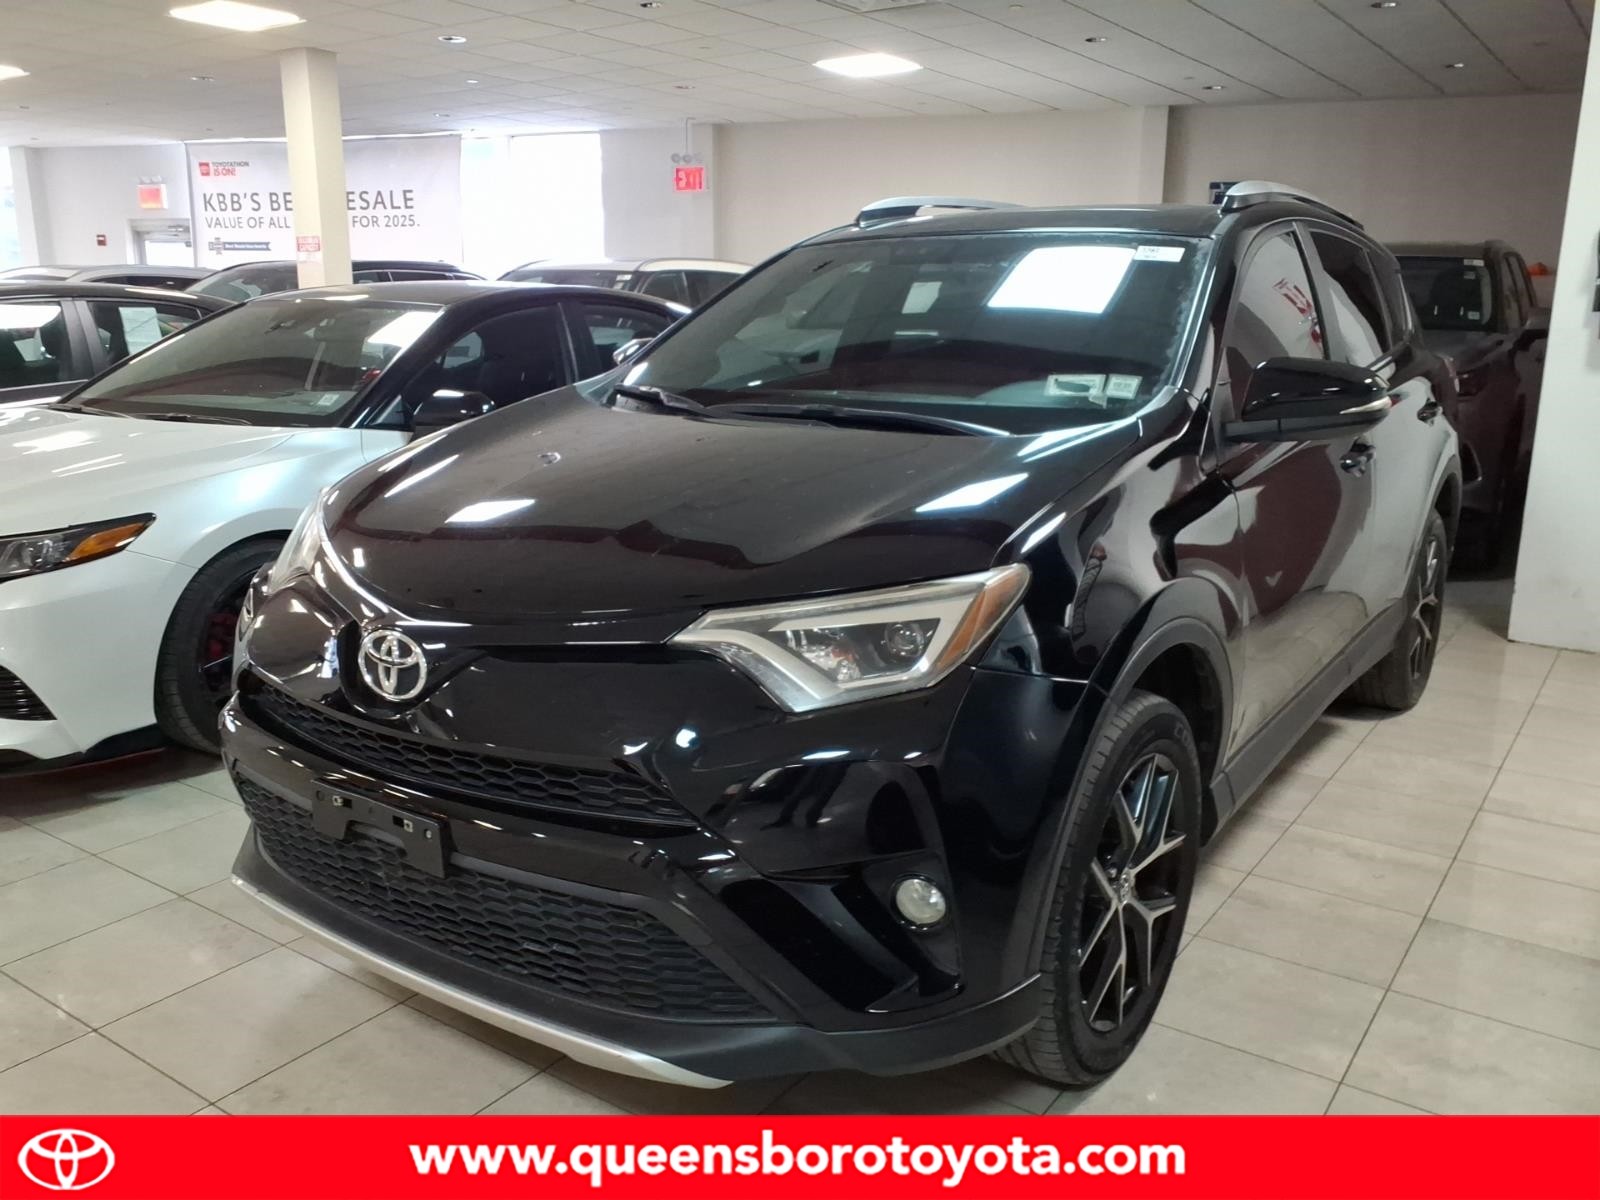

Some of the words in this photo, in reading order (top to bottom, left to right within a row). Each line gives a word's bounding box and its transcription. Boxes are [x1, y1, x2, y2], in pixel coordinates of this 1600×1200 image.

[675, 167, 704, 191] EXIT
[203, 192, 262, 212] KBB'S
[268, 191, 294, 212] BE
[346, 189, 414, 211] ESALE
[205, 216, 244, 229] VALUE
[247, 216, 265, 229] OF
[268, 216, 291, 229] ALL
[352, 215, 380, 229] FOR
[384, 214, 420, 228] 2025.
